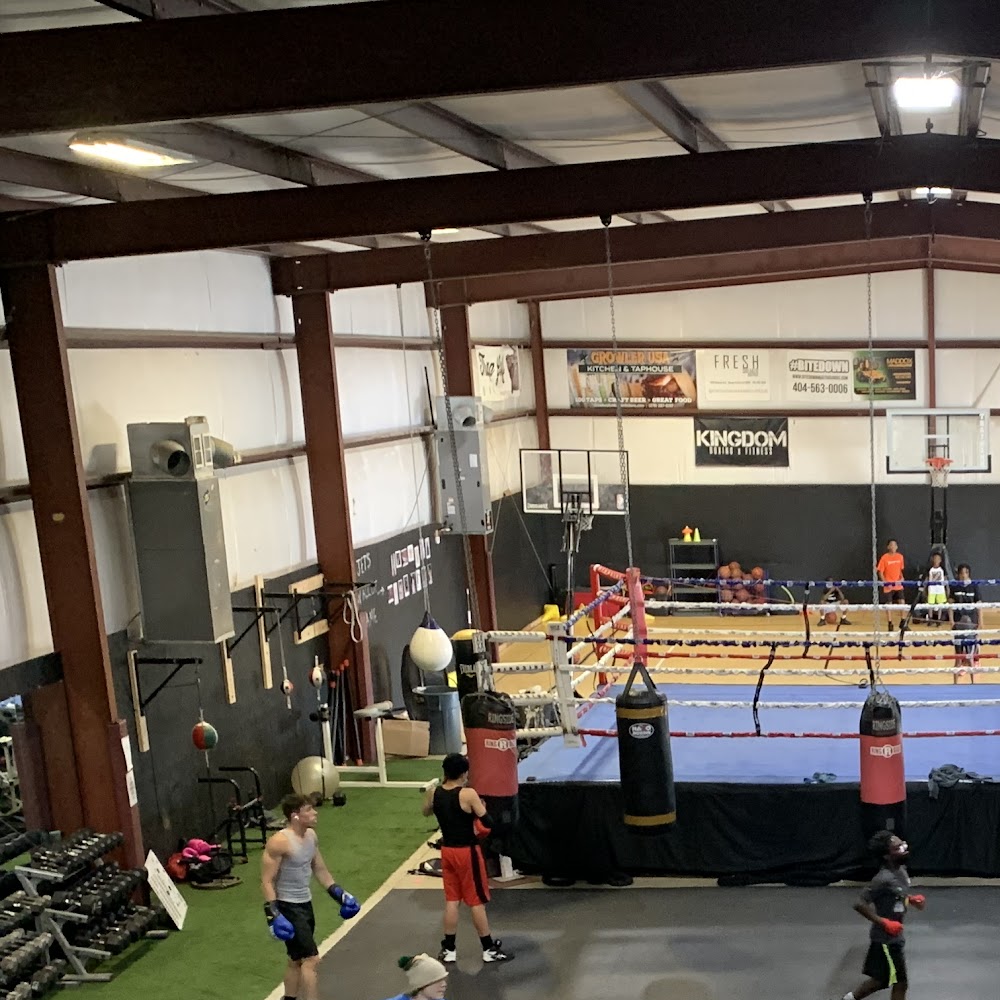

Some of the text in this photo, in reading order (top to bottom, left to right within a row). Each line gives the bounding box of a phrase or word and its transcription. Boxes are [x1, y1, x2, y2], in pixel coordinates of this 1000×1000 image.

[714, 354, 759, 369] FRESH
[789, 358, 849, 373] #BITEDOWN
[623, 365, 629, 373] &
[631, 365, 674, 373] TAPHOUSE
[793, 382, 848, 393] 404-563-0006
[696, 430, 787, 447] KINGDOM
[745, 446, 773, 456] FITNESS
